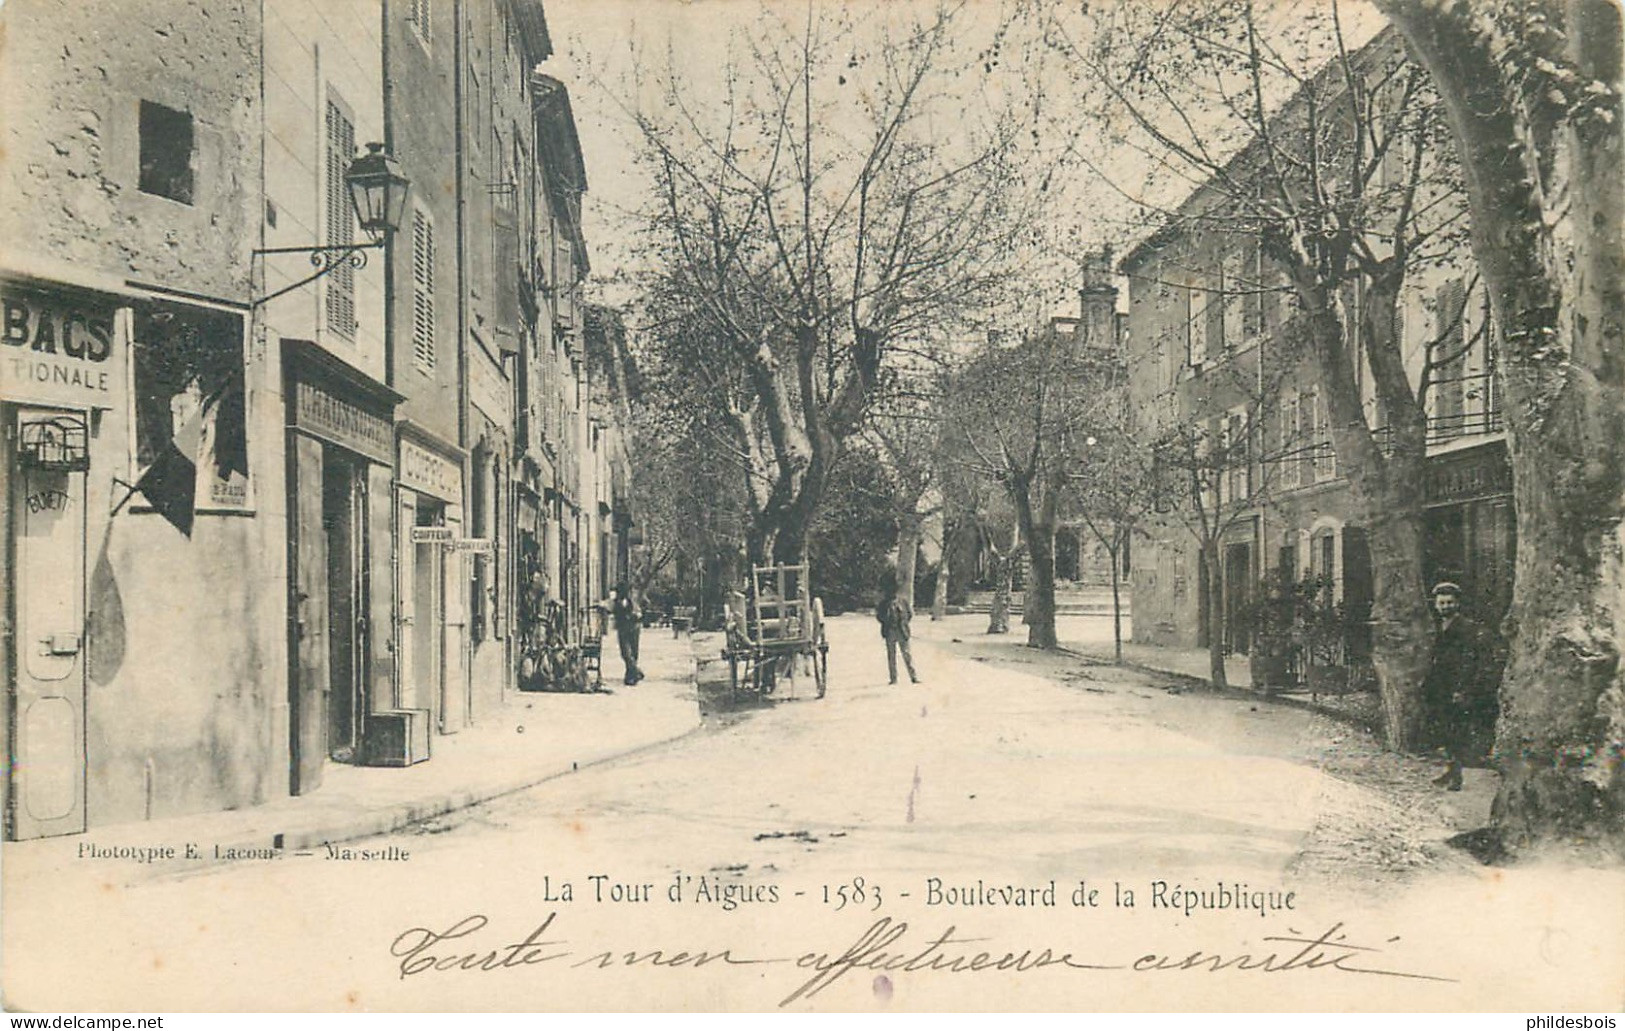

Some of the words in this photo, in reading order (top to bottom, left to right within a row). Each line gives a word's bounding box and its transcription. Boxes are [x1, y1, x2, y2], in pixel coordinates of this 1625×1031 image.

[1, 301, 112, 363] BACS
[412, 529, 452, 540] COIFFEUR
[78, 841, 176, 864] Phototypie
[184, 843, 203, 859] E.
[325, 841, 410, 862] Marseille
[543, 875, 574, 903] La
[588, 875, 654, 902] Tour
[668, 876, 781, 911] d'Aigues
[822, 876, 884, 911] 1583
[926, 877, 1057, 907] Boulevard
[1071, 880, 1100, 908] de
[1115, 882, 1136, 909] la
[1150, 880, 1297, 918] République
